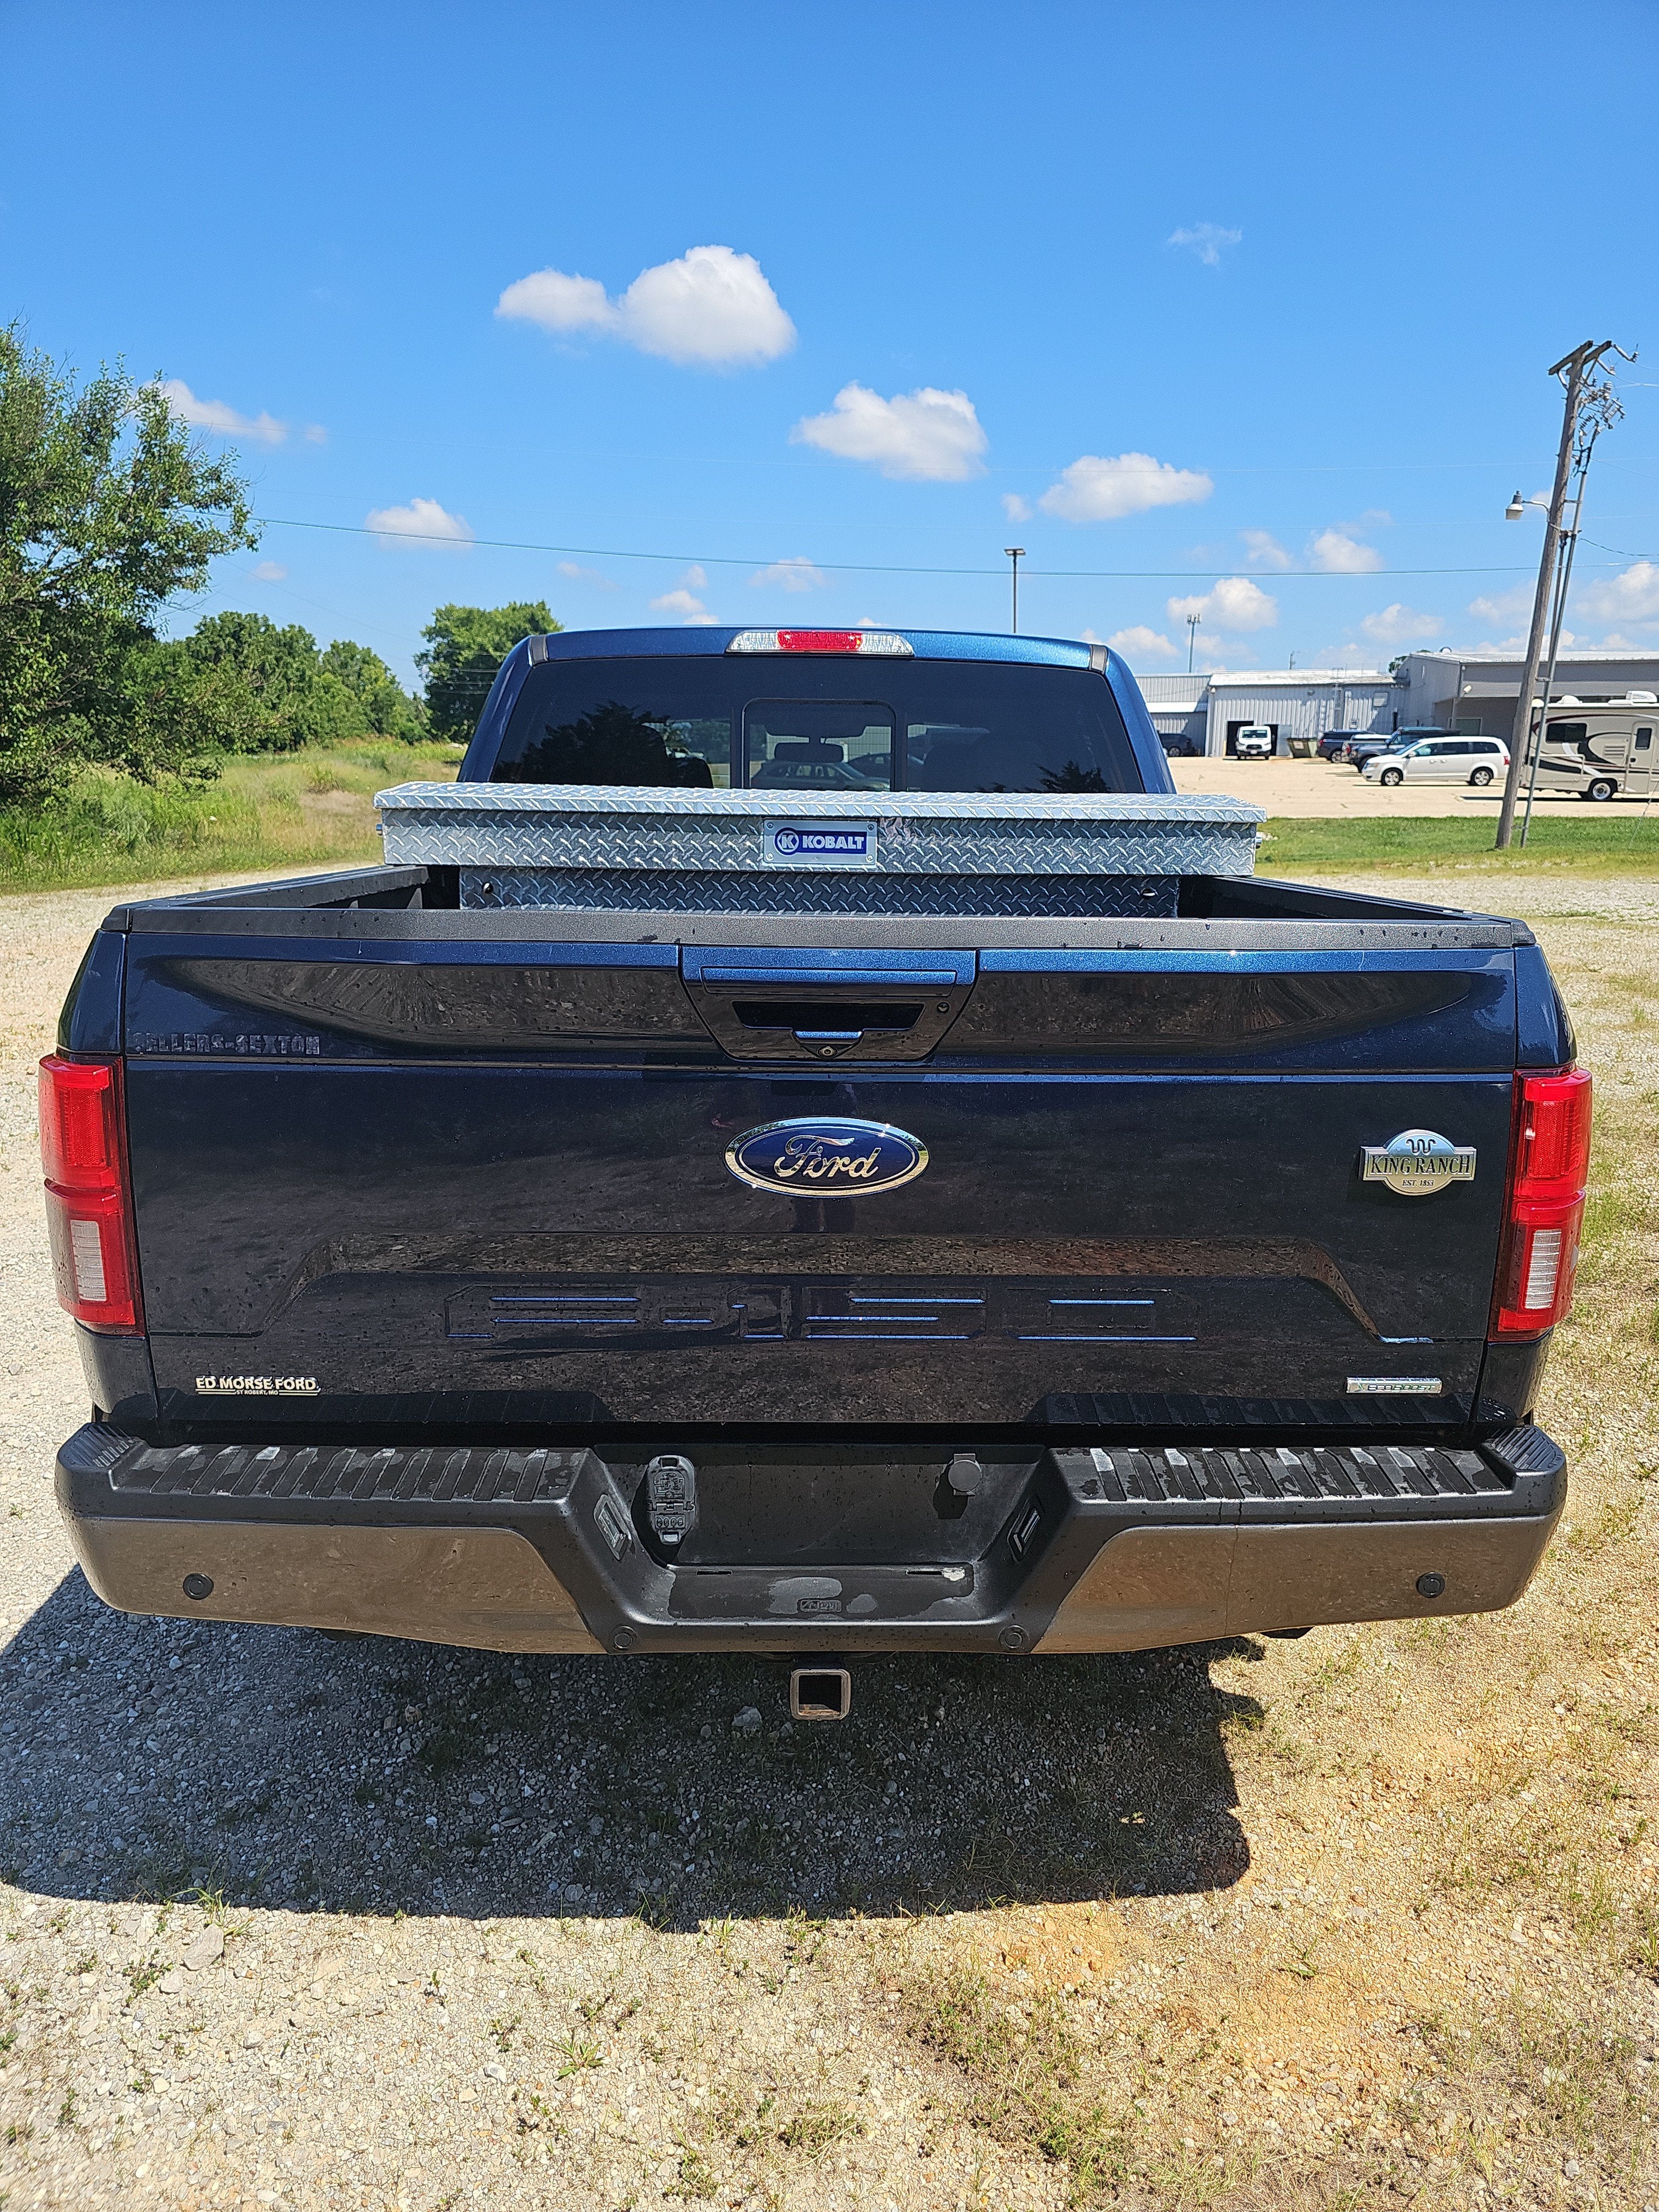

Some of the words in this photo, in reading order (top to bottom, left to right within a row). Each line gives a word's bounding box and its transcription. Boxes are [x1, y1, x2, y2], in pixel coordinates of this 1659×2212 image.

[802, 835, 865, 850] KOBALT
[774, 1134, 879, 1178] Ford
[1369, 1154, 1411, 1175] KING
[1414, 1154, 1471, 1175] RANCH
[1401, 1179, 1418, 1187] EST.
[1419, 1179, 1435, 1187] 1853
[195, 1375, 217, 1389] ED
[219, 1375, 273, 1390] MORSE
[274, 1376, 318, 1391] FORD
